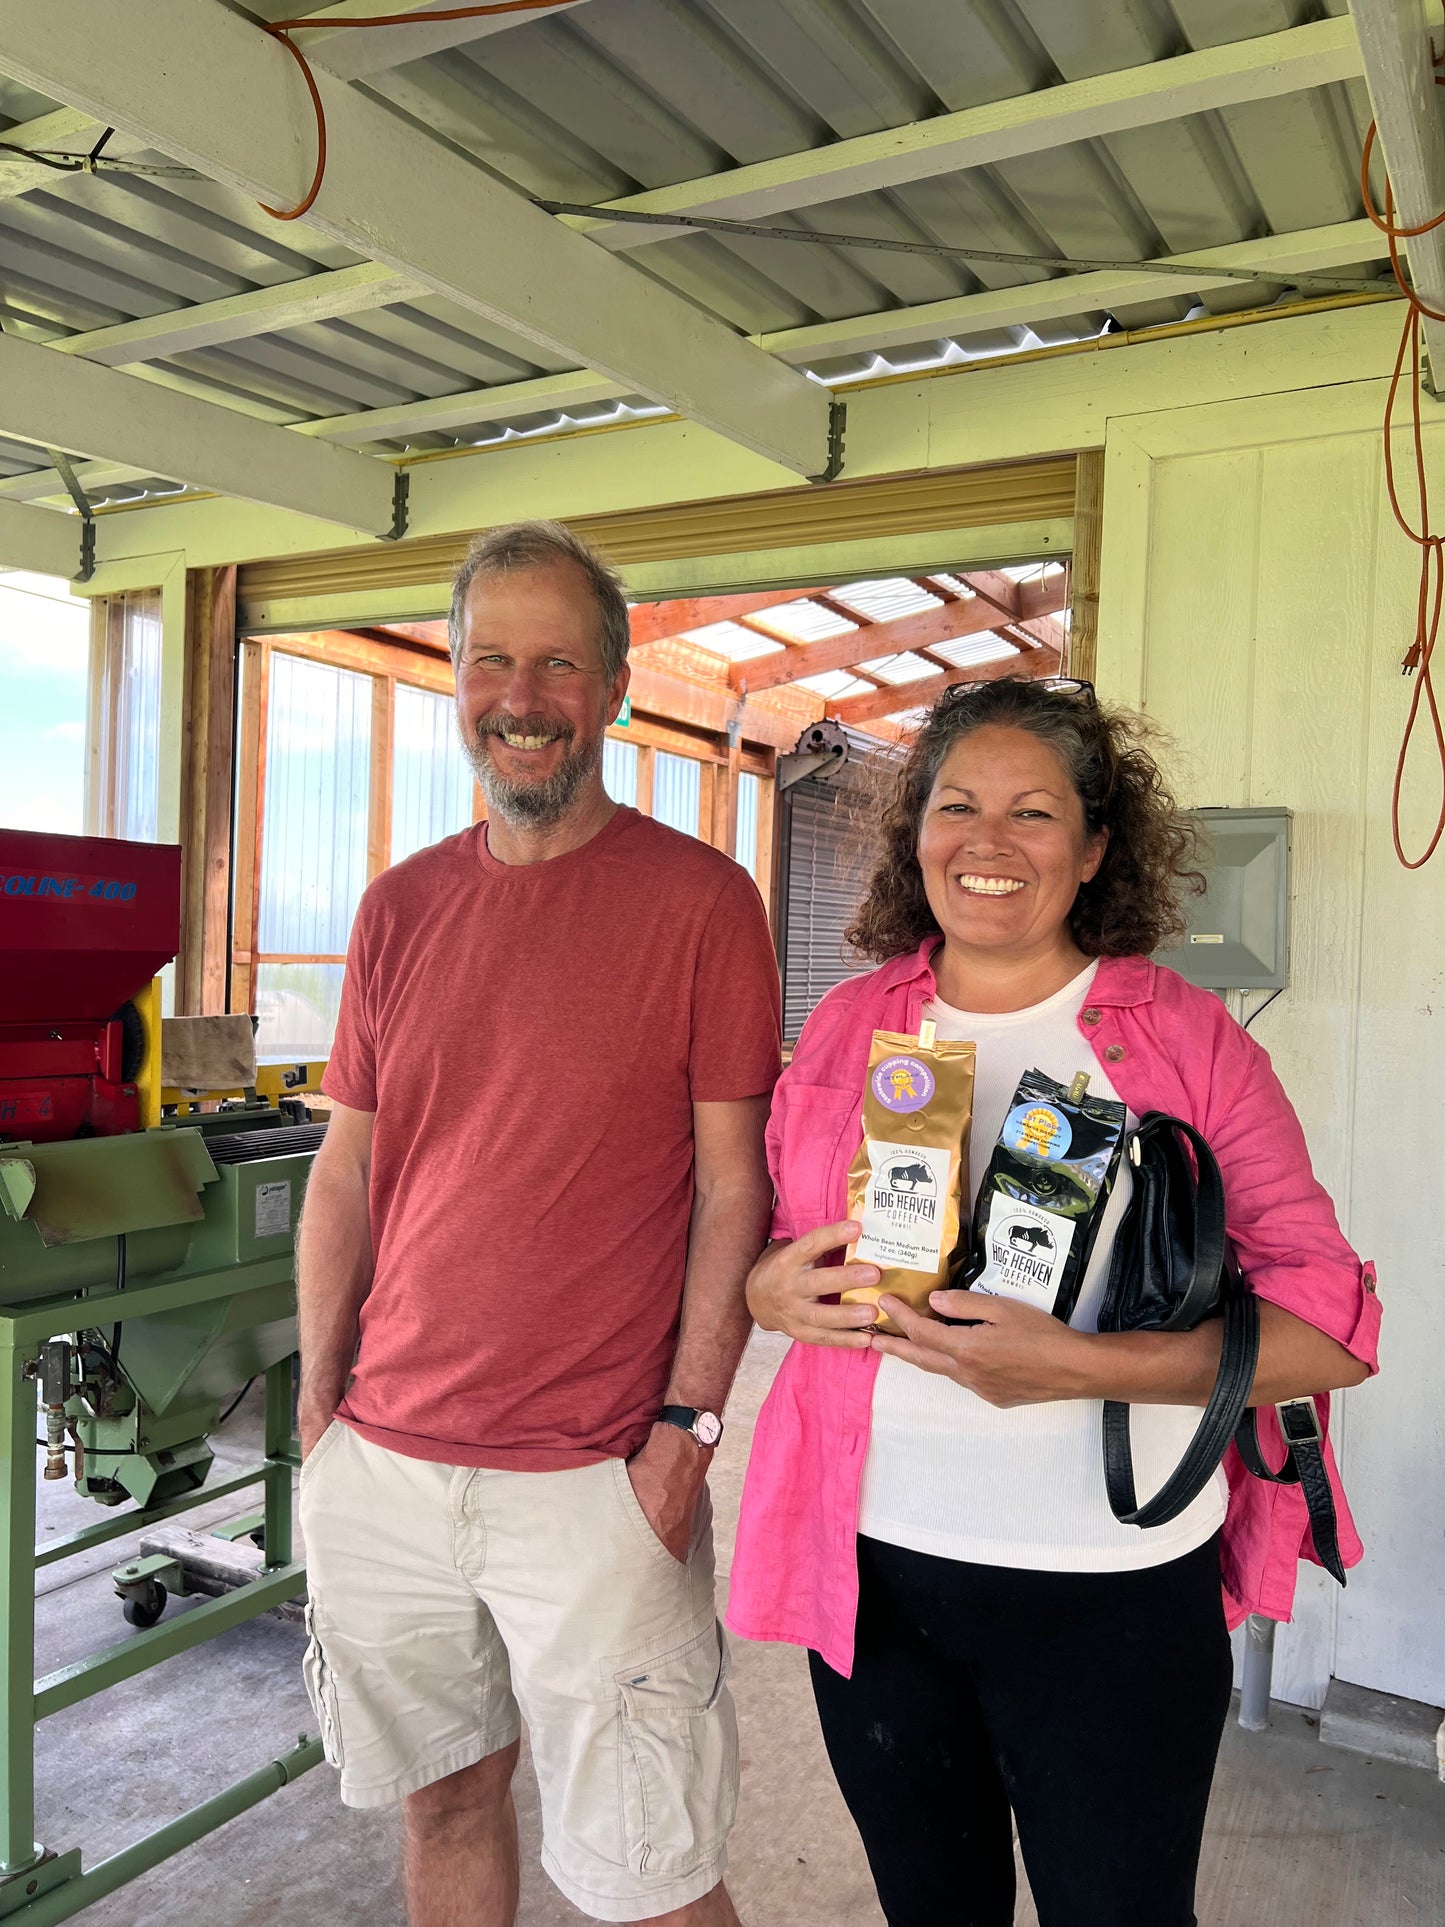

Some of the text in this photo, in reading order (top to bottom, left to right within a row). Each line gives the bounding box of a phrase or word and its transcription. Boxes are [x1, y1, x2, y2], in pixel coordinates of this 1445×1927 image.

[881, 1059, 909, 1072] cupping
[910, 1061, 931, 1097] competition
[873, 1190, 936, 1220] HOG HEAVEN
[887, 1209, 919, 1224] COFFEE
[861, 1233, 939, 1254] Whole Bean Medium Roast
[898, 1249, 918, 1259] (340g)
[992, 1243, 1053, 1286] HOG HEAVEN
[1000, 1266, 1032, 1285] COFFEE
